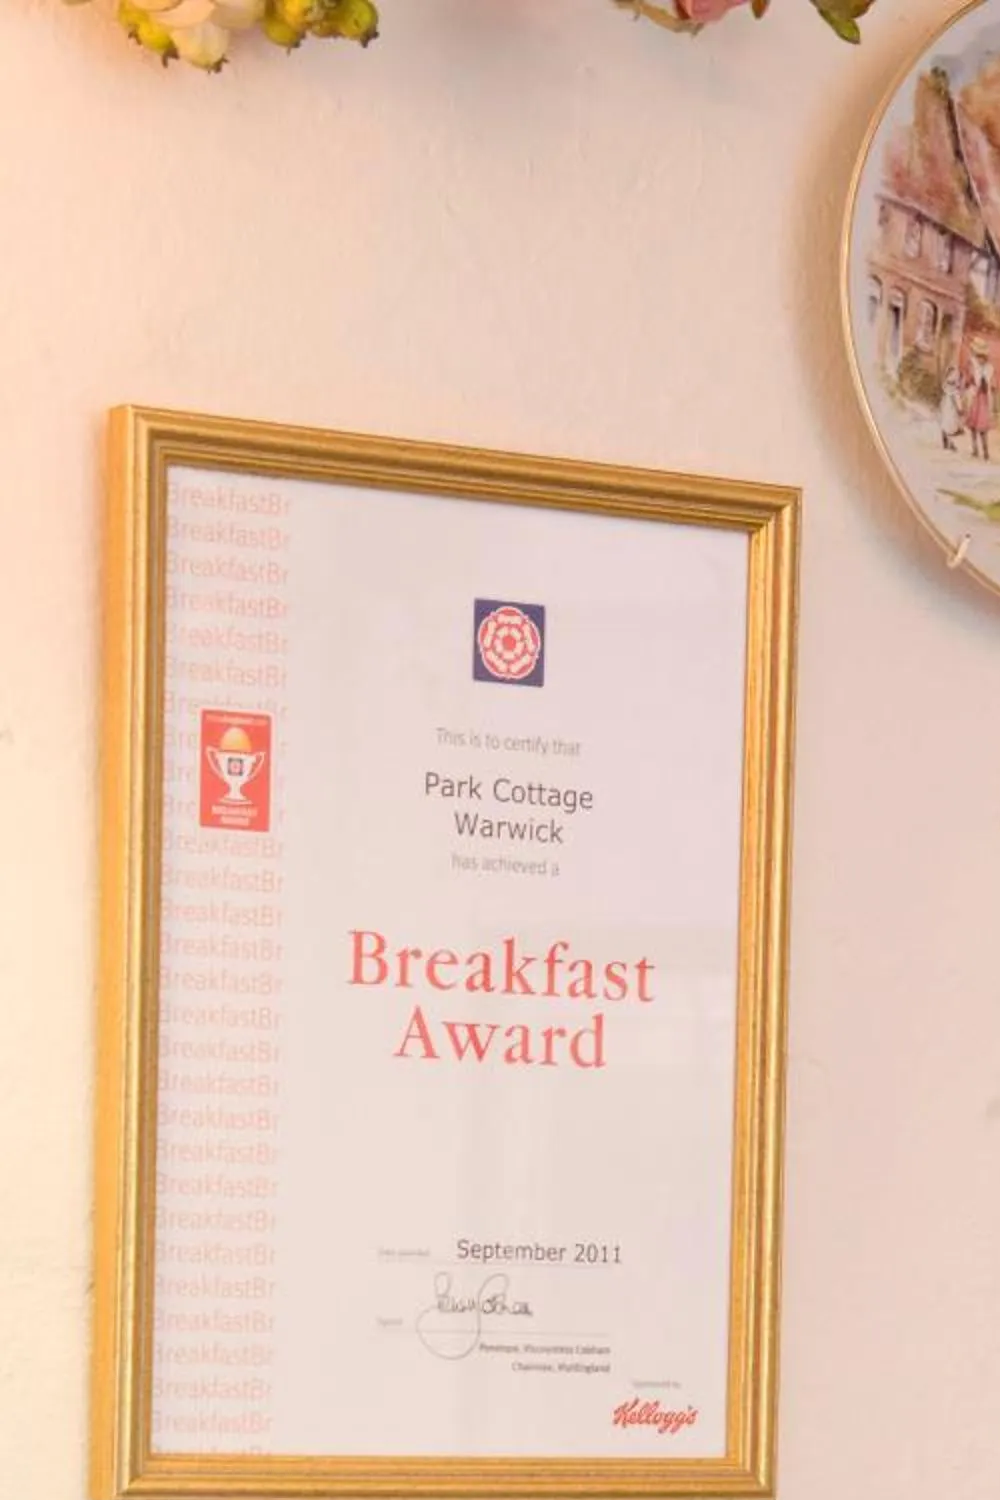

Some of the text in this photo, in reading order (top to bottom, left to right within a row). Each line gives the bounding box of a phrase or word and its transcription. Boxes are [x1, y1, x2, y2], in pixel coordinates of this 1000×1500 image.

[437, 727, 580, 756] This is to certify that
[425, 772, 593, 814] Park Cottage
[454, 812, 564, 844] Warwick
[451, 853, 560, 877] has achieved a
[347, 929, 656, 1003] Breakfast
[393, 1005, 607, 1069] Award
[456, 1239, 566, 1264] September
[574, 1243, 622, 1264] 2011
[612, 1396, 698, 1434] Kellogg's
